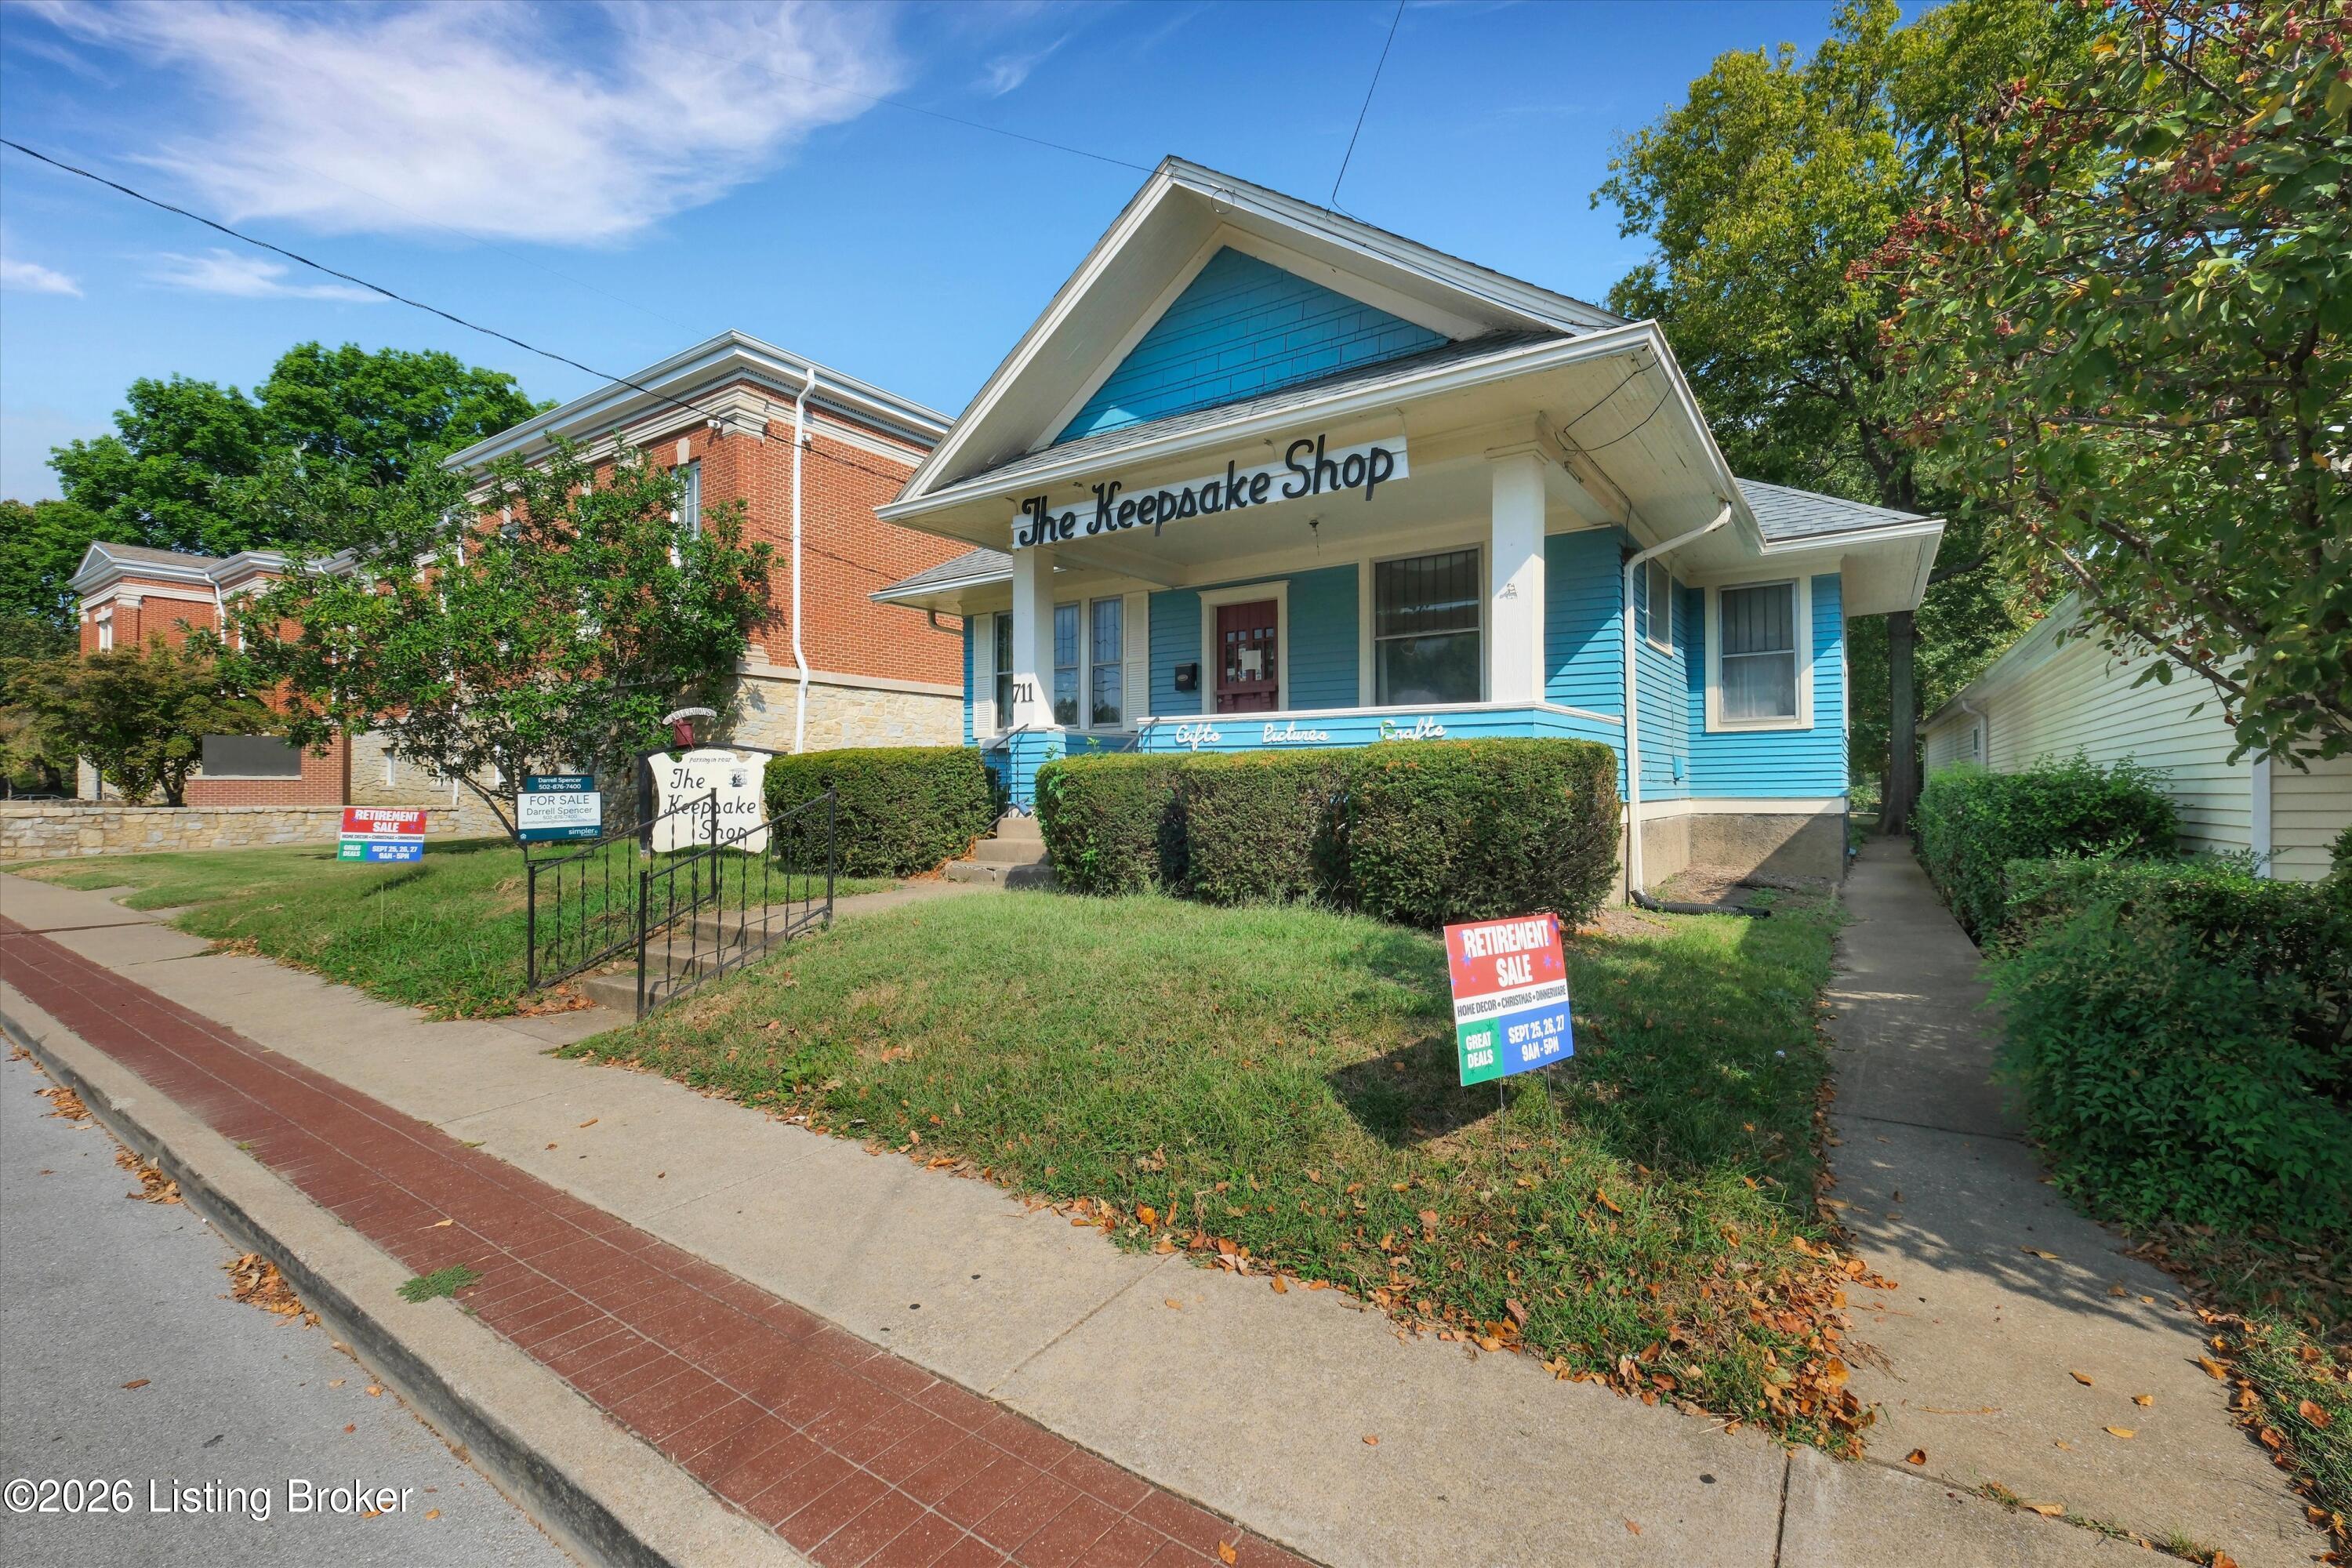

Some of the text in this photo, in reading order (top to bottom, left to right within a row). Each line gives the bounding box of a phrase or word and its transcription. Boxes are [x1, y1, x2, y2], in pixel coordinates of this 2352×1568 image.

[1018, 434, 1395, 546] The Keepsake Shop
[1013, 682, 1034, 703] 711
[669, 707, 712, 722] ALTERATIONS
[1176, 716, 1446, 750] Gifts Pictures Crafts
[670, 768, 705, 789] The
[529, 795, 590, 805] FOR SALE
[354, 809, 419, 822] RETIREMENT
[372, 822, 400, 833] SALE
[568, 828, 595, 837] simpler
[1462, 920, 1550, 958] RETIREMENT
[1496, 954, 1533, 987] SALE
[1457, 985, 1566, 1017] HOME DECOR CHRISTMAS DINNERWARE
[1508, 1014, 1565, 1044] SEPT 25, 26, 27
[1465, 1031, 1491, 1051] GREAT
[1468, 1051, 1494, 1069] DEALS
